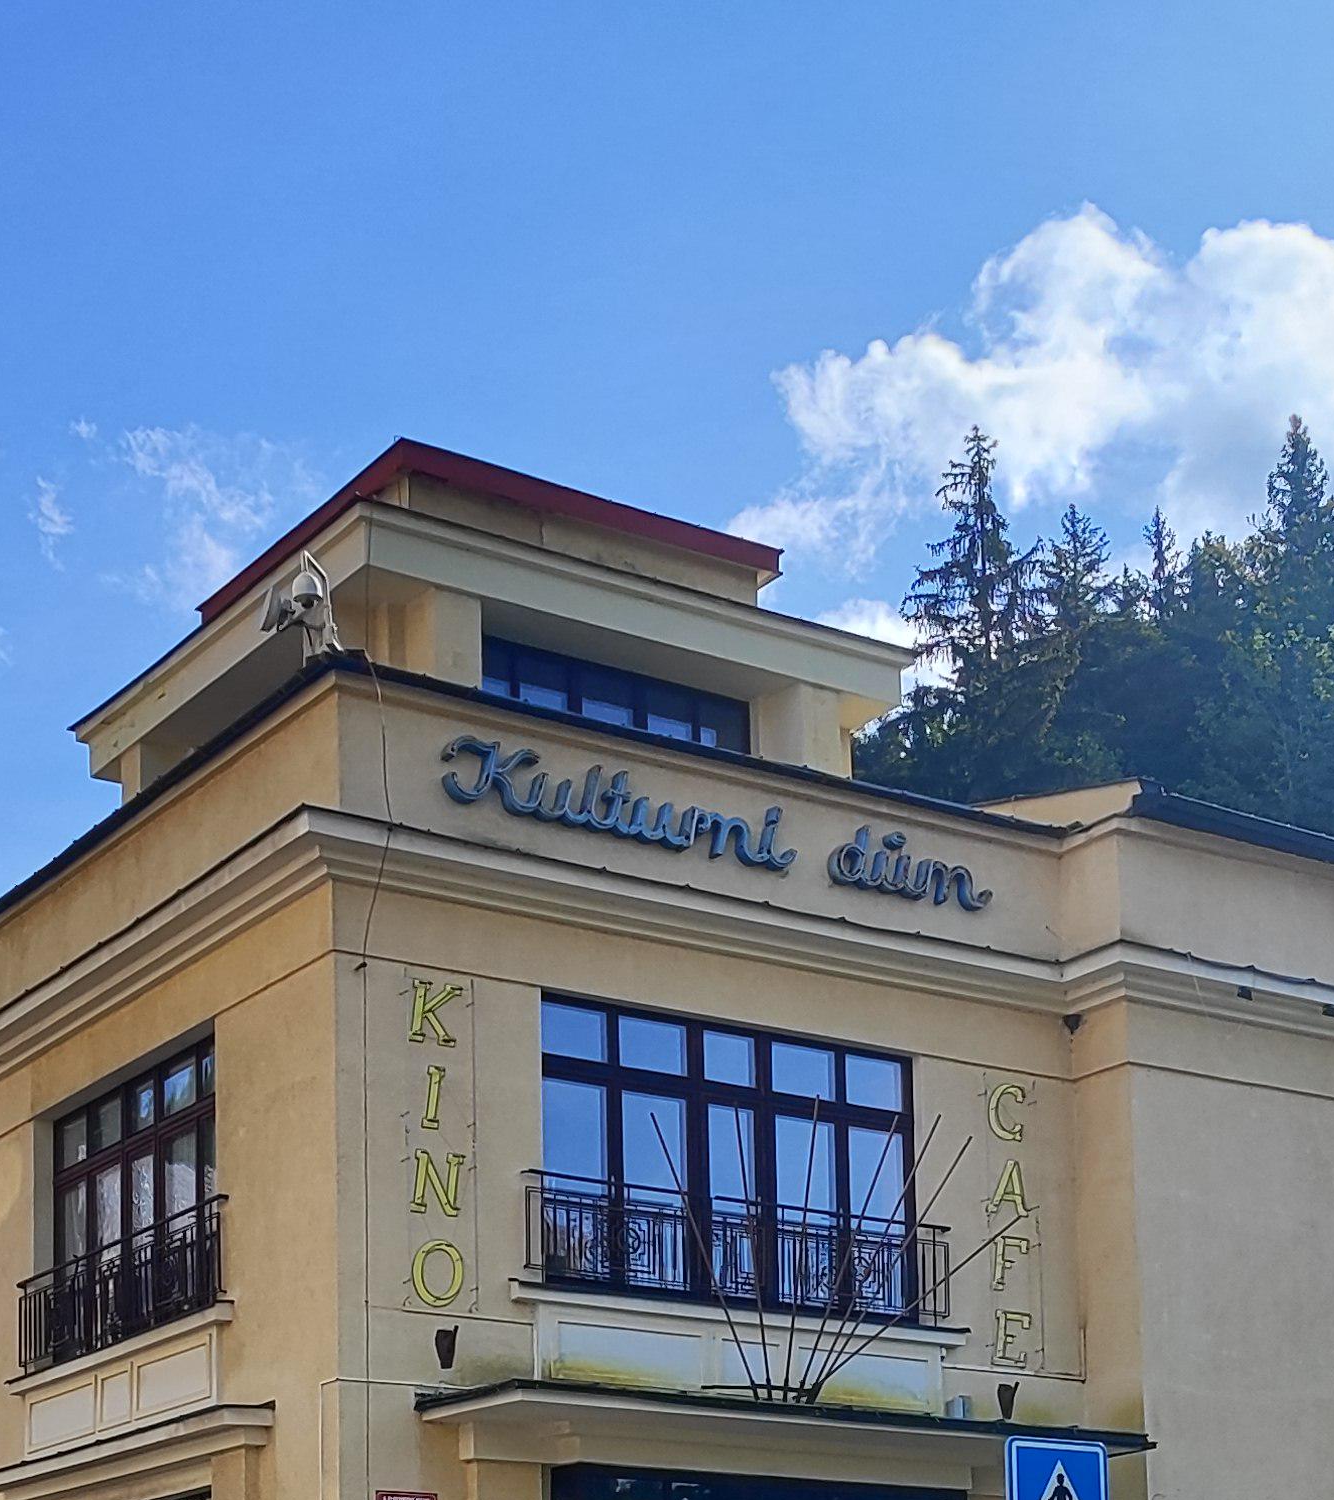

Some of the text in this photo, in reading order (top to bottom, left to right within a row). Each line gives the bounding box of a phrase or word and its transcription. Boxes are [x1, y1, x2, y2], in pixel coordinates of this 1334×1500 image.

[827, 824, 994, 912] dům
[408, 978, 466, 1308] KINO
[986, 1083, 1032, 1368] CAFE
